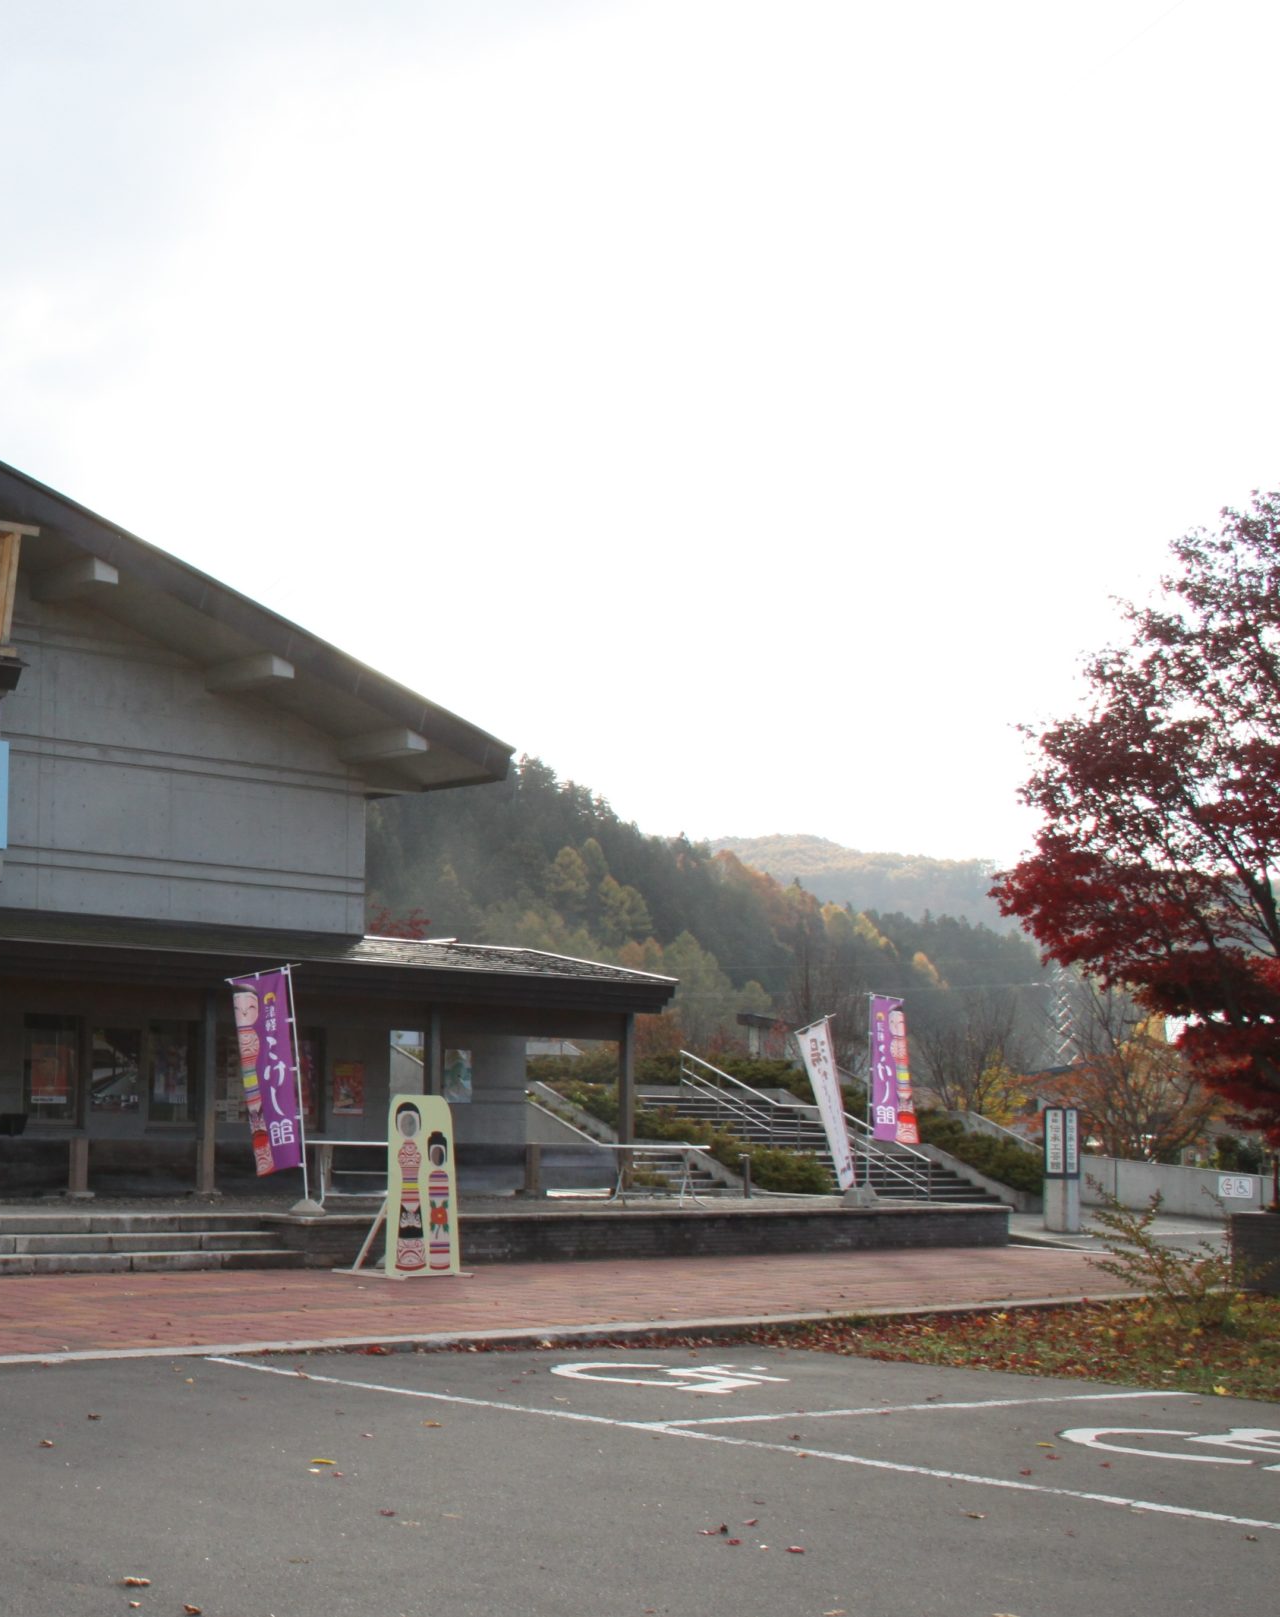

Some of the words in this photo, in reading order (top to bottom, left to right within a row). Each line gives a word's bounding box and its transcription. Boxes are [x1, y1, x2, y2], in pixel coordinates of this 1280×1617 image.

[263, 1005, 295, 1147] 津軽こけし館
